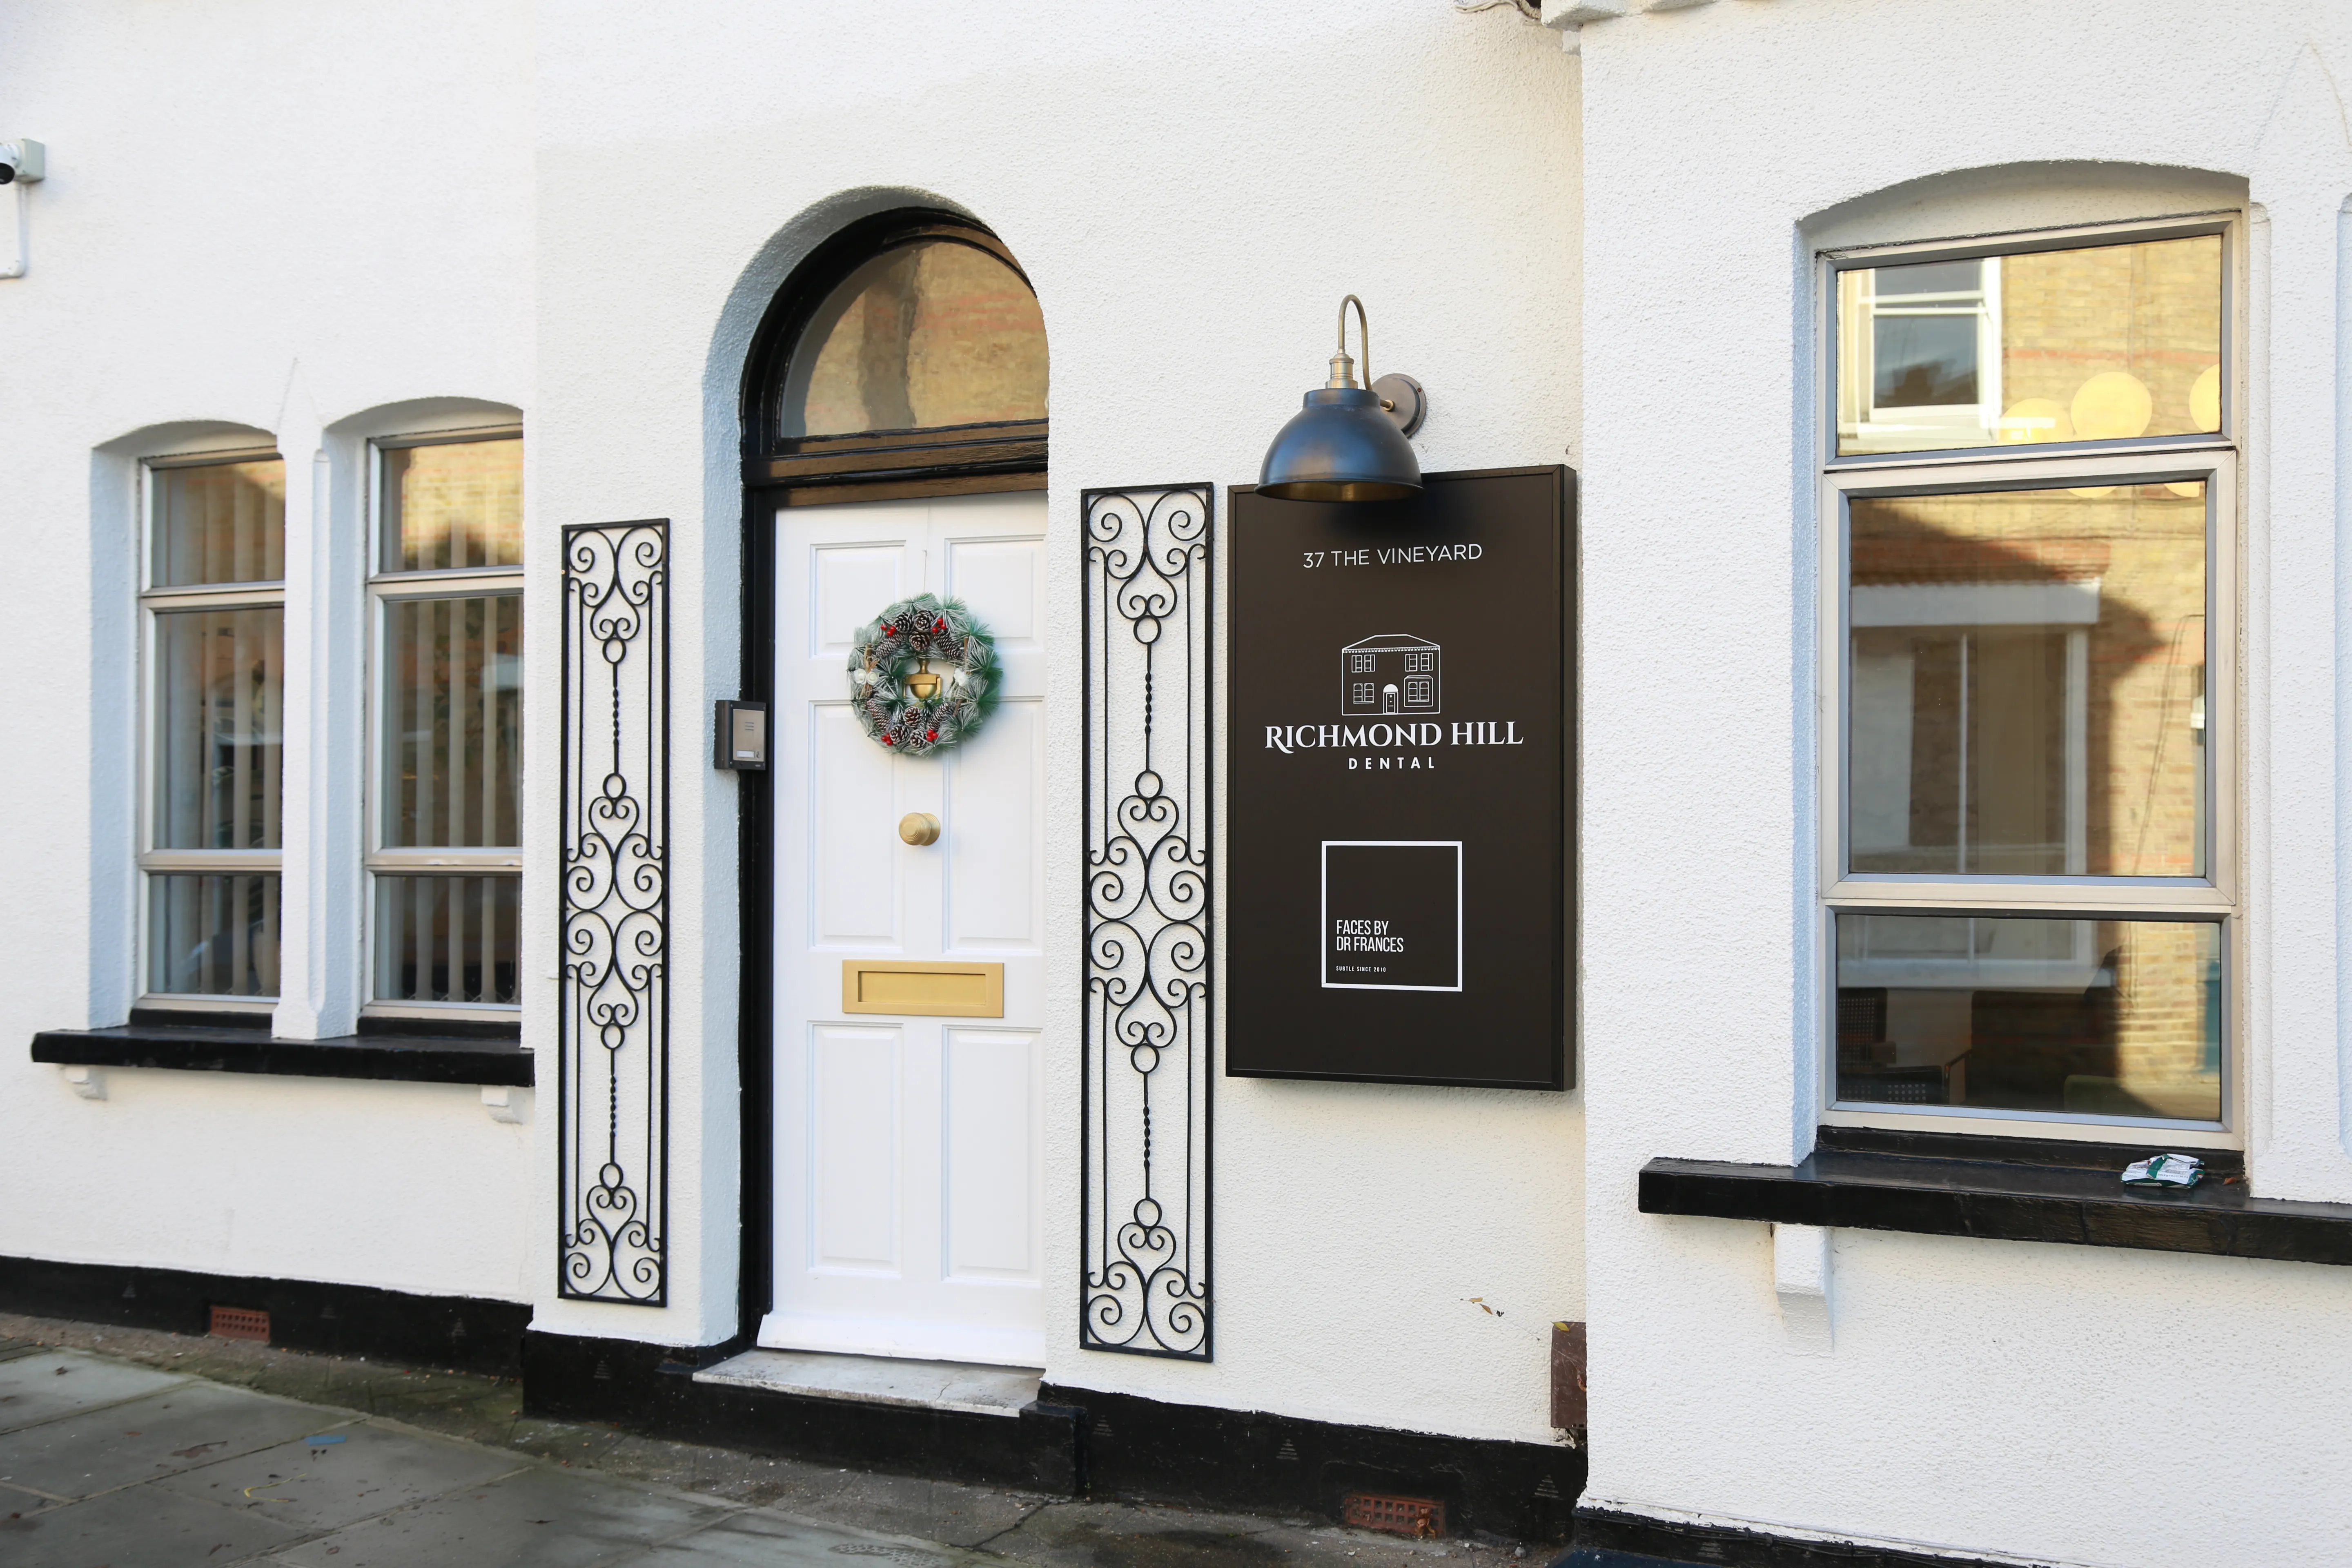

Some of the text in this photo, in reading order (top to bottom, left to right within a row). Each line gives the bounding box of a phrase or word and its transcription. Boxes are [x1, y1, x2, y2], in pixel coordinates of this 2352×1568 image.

[1303, 543, 1482, 568] 37 THE VINEYARD
[1265, 722, 1524, 754] RICHMOND HILL
[1349, 757, 1434, 770] DENTAL
[1336, 920, 1389, 935] FACES BY
[1336, 936, 1404, 952] DR FRANCES
